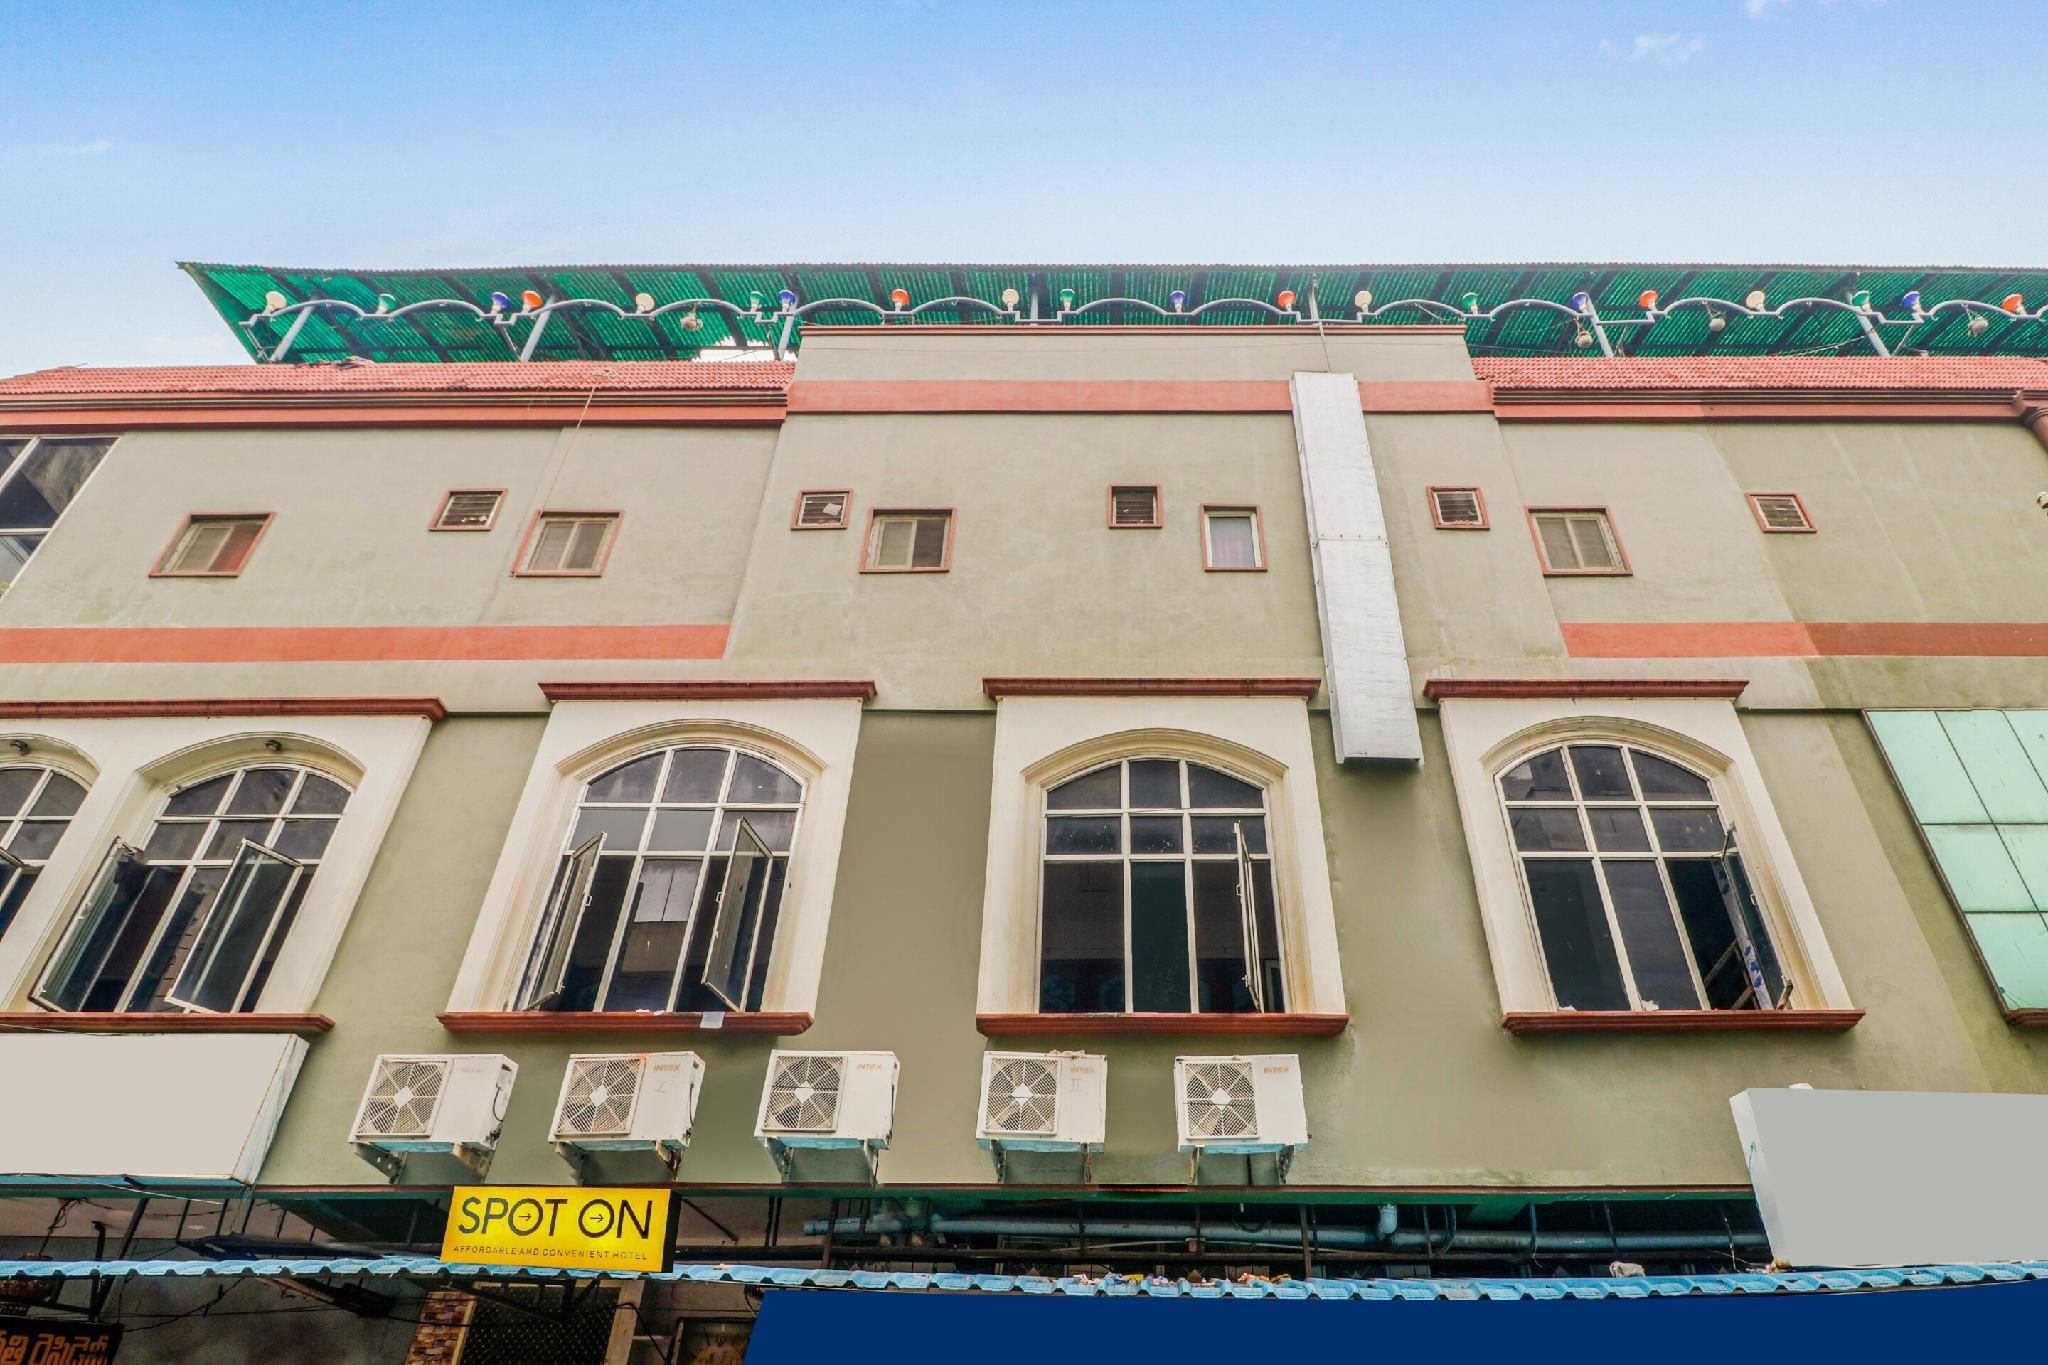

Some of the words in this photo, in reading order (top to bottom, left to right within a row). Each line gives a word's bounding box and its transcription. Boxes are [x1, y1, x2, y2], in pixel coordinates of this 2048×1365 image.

[458, 1196, 568, 1237] SPOT
[578, 1198, 653, 1240] ON
[453, 1245, 517, 1256] AFFORDABLE
[519, 1247, 540, 1256] AND
[542, 1248, 609, 1259] CONVENIENT
[613, 1251, 647, 1261] HOTEL
